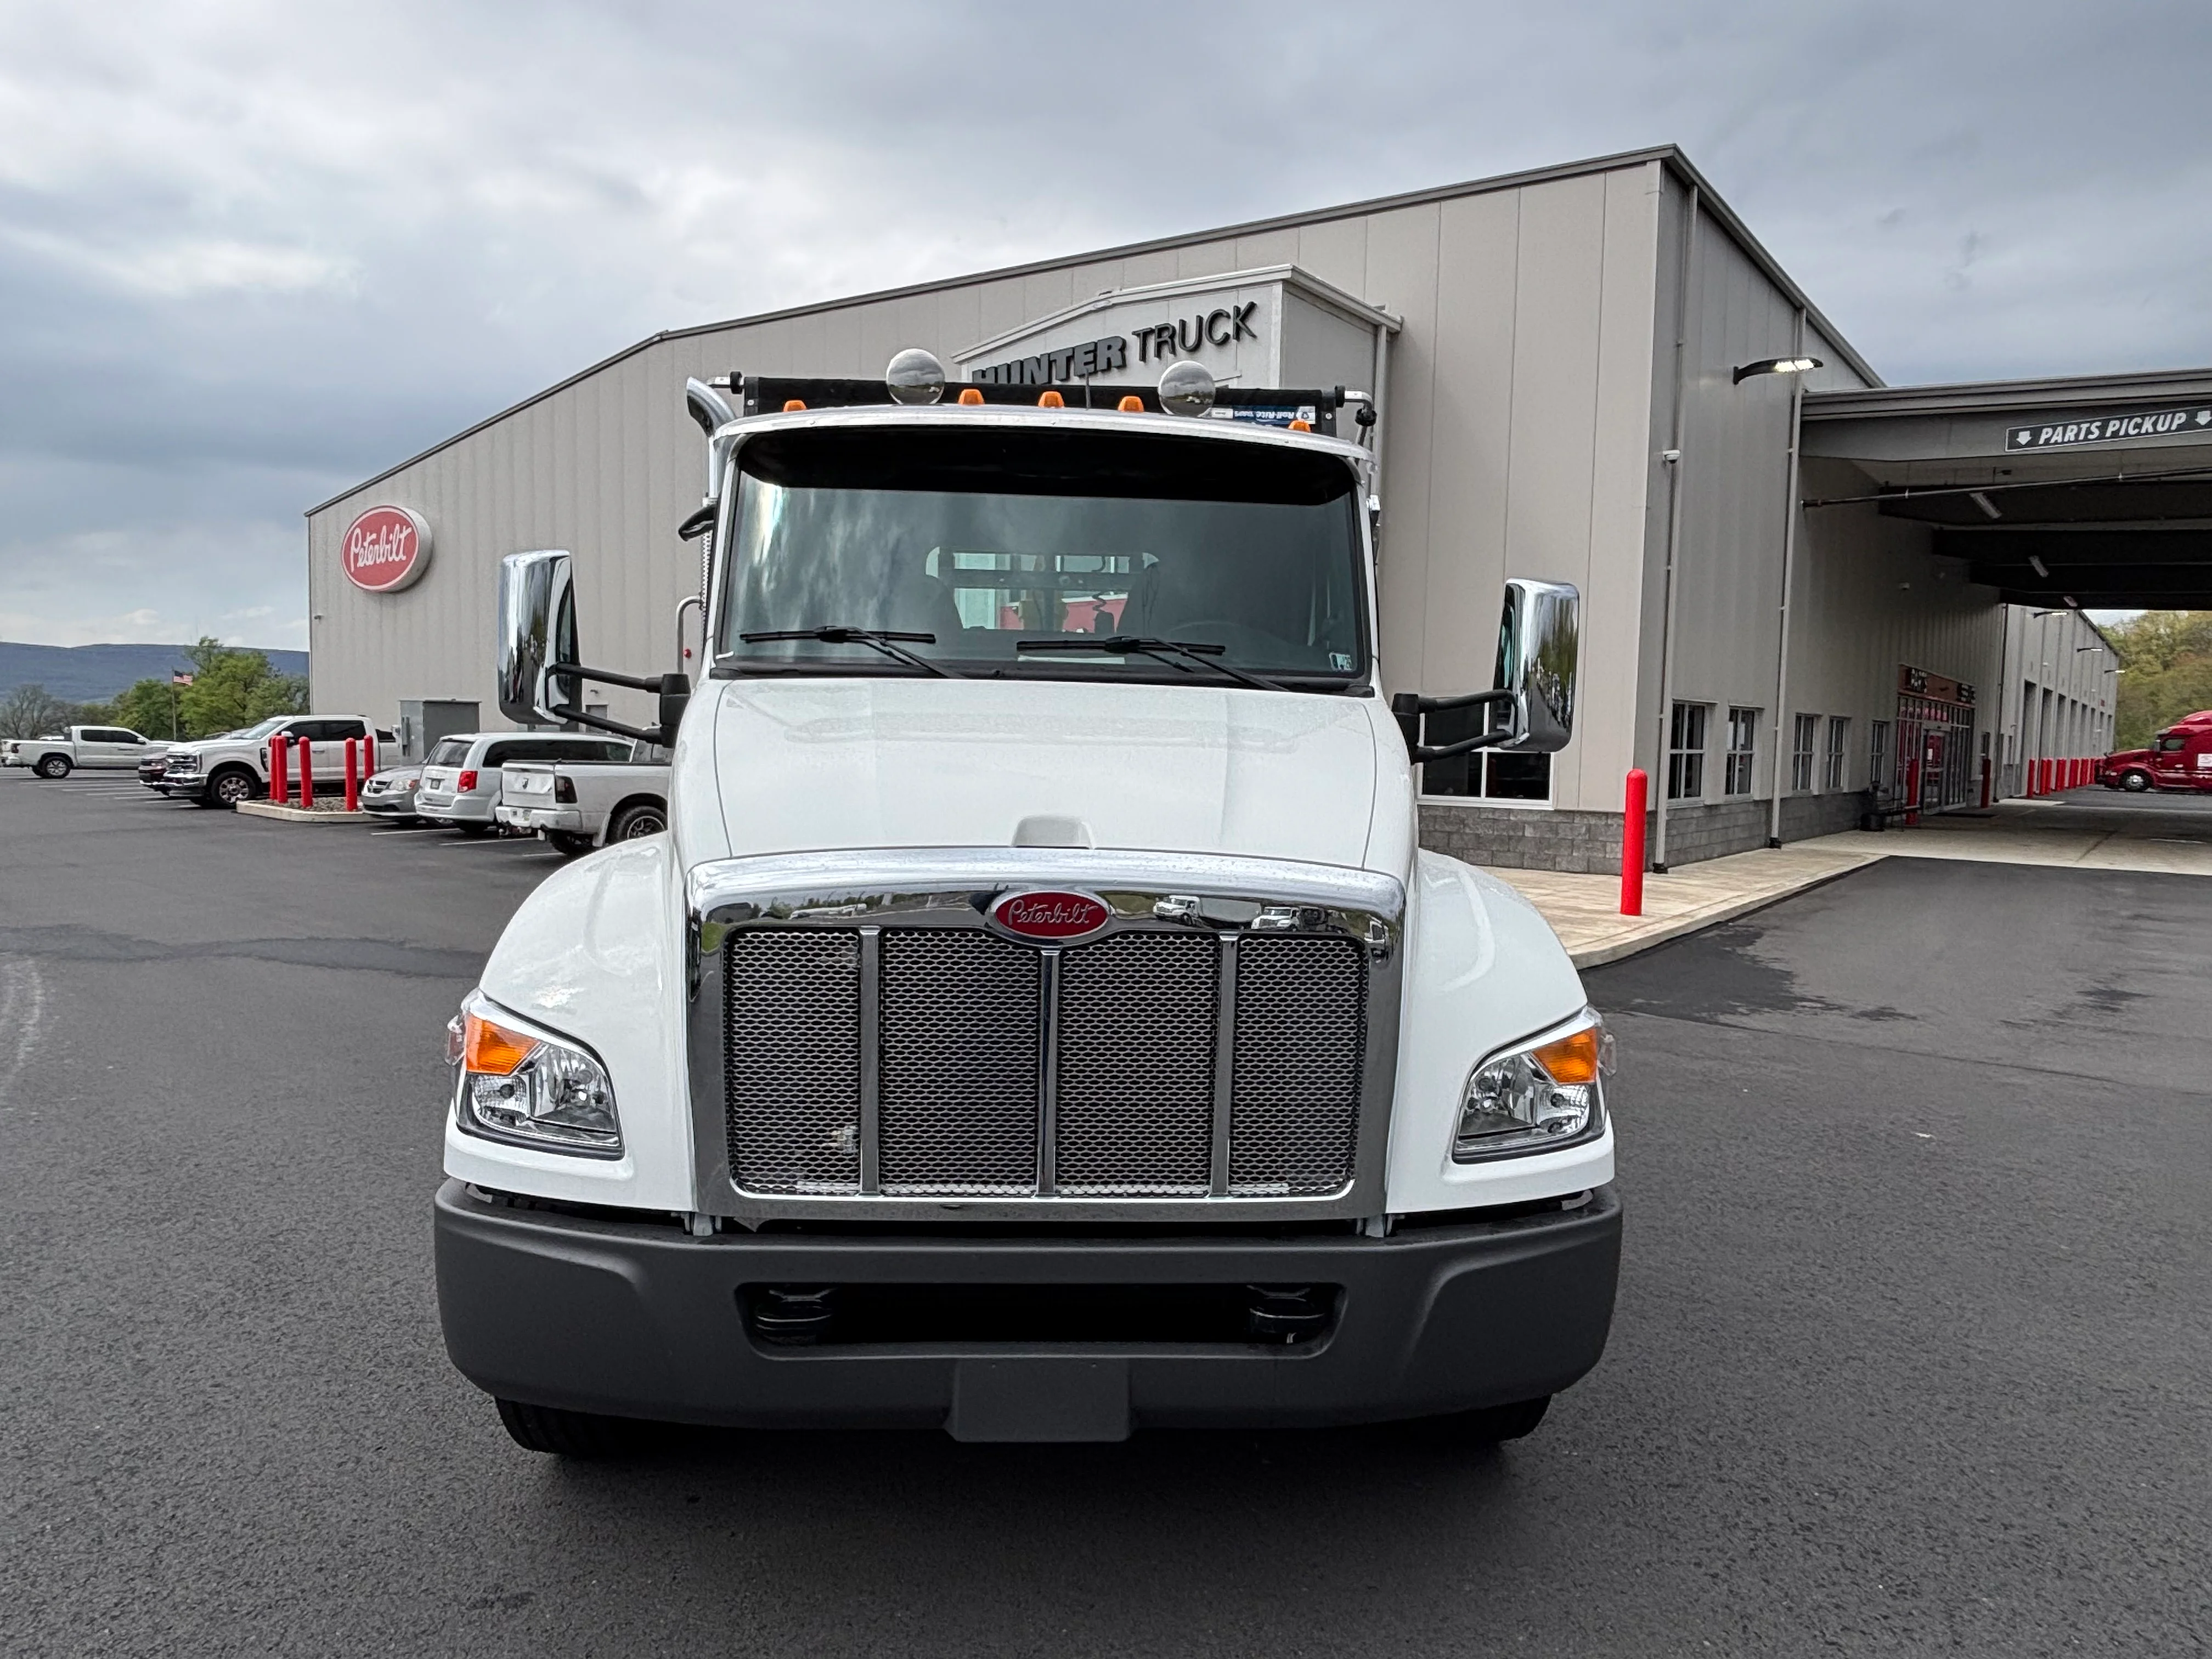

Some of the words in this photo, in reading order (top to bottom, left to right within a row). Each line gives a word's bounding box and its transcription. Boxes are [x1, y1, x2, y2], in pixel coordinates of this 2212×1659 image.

[1132, 301, 1257, 363] TRUCK
[2039, 421, 2101, 444] PARTS
[2105, 413, 2187, 437] PICKUP
[350, 523, 412, 573] Peterbilt
[1007, 899, 1098, 926] Peterbilt
